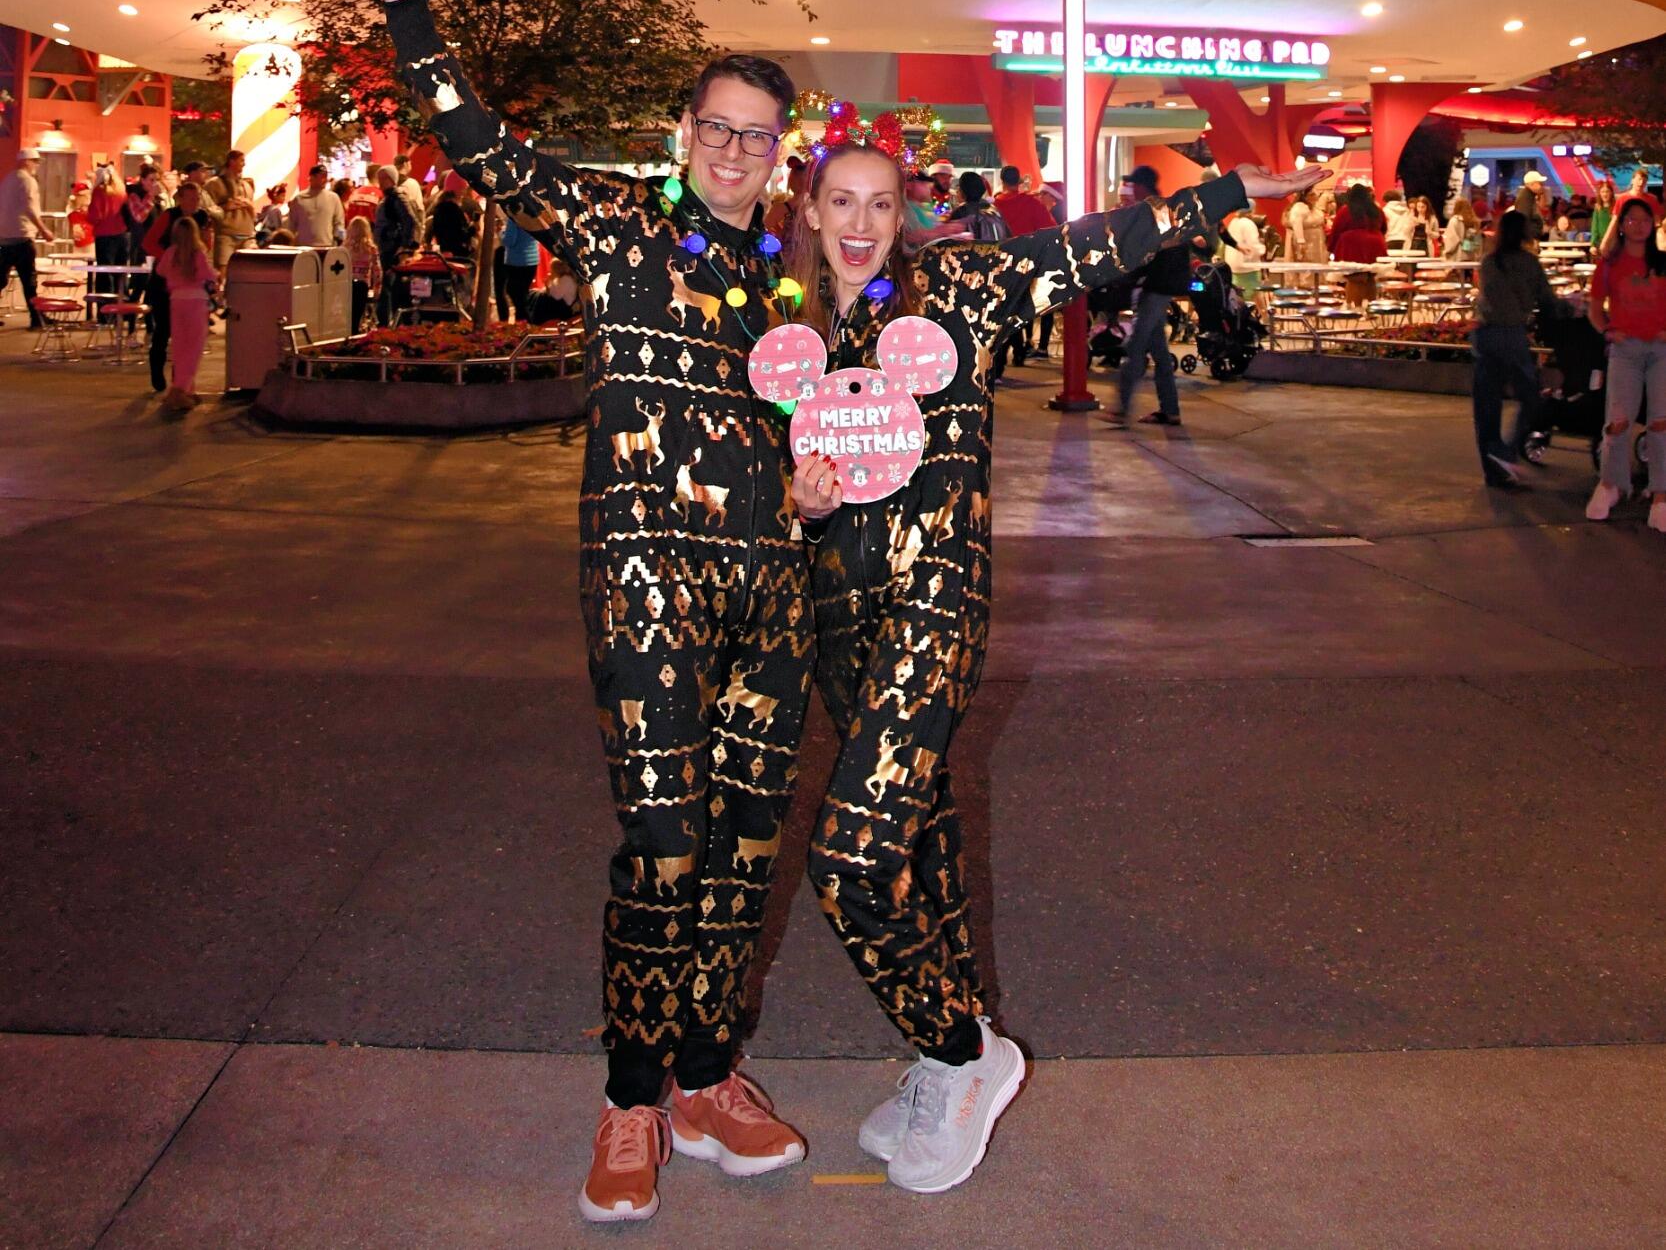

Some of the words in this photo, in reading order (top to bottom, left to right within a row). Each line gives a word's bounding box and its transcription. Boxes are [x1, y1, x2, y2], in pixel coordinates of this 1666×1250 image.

[1085, 32, 1262, 62] LUNCHING
[1272, 39, 1330, 65] PAD
[819, 405, 892, 429] MERRY
[795, 431, 921, 455] CHRISTMAS
